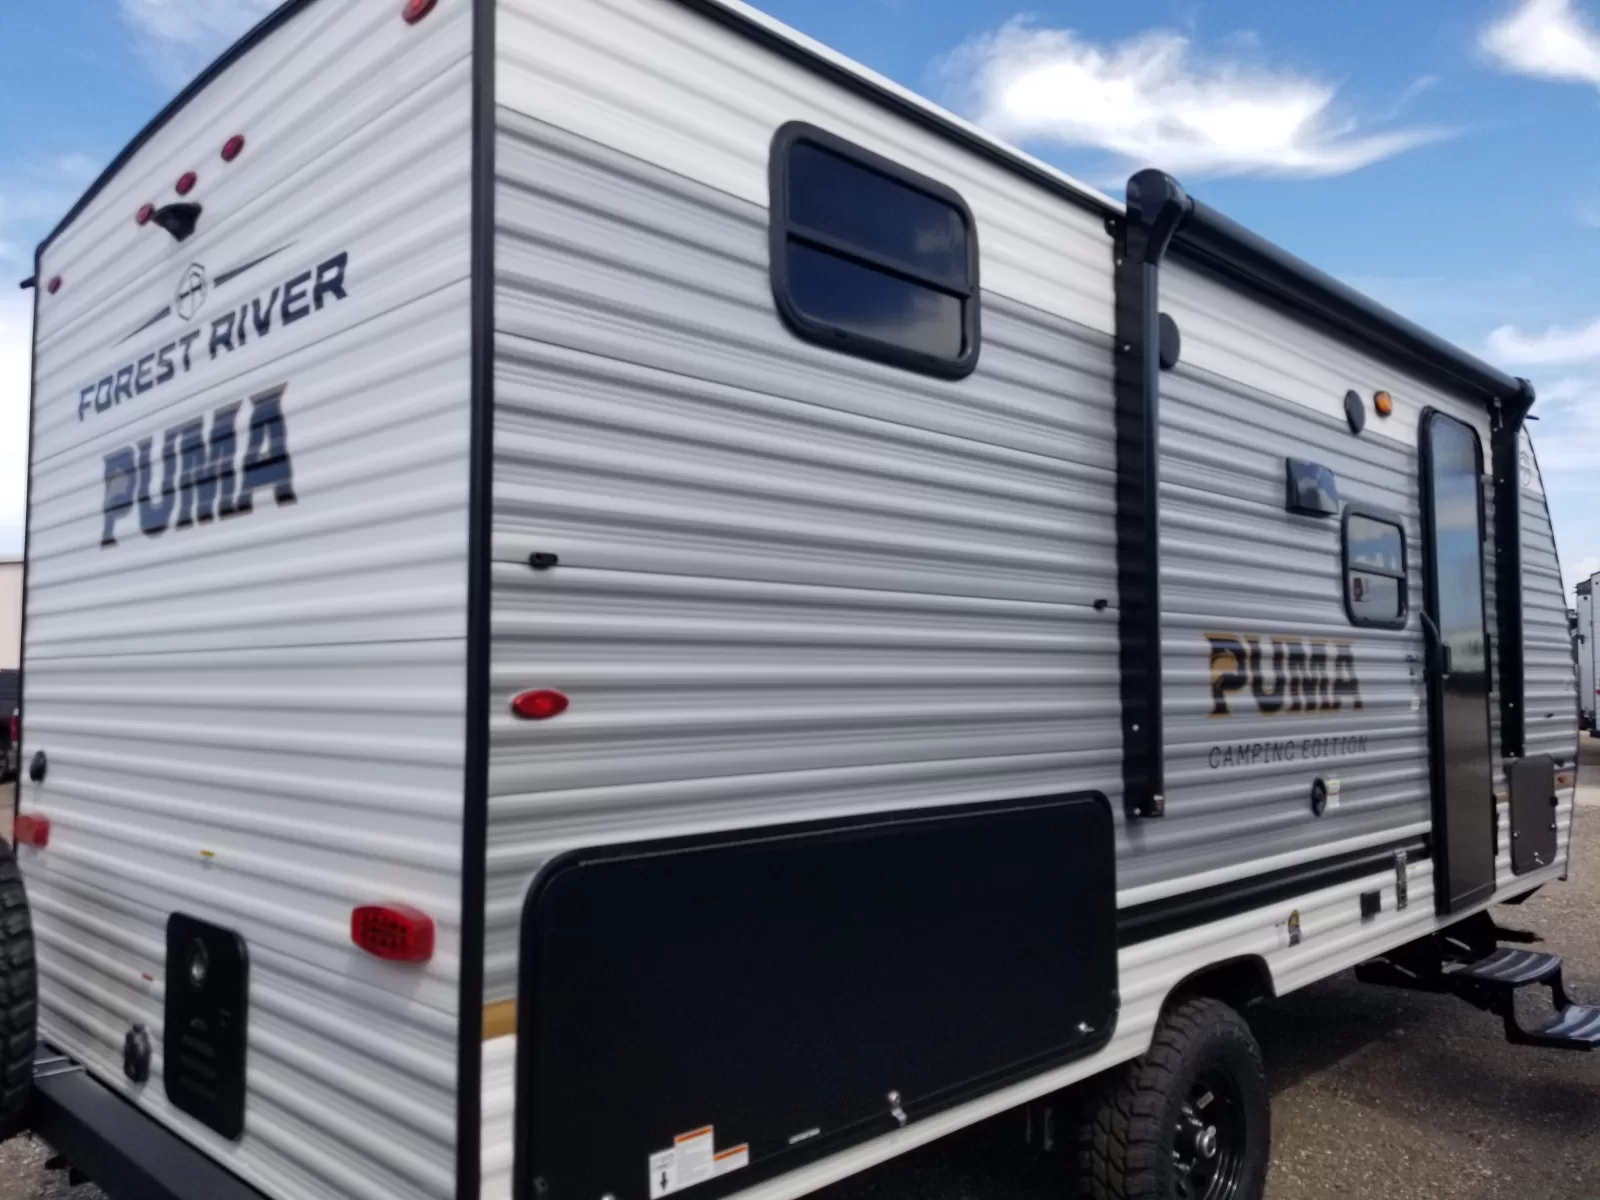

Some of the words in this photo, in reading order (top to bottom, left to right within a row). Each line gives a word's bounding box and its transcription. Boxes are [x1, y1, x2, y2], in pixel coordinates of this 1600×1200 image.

[78, 329, 201, 421] FOREST
[208, 251, 348, 360] RIVER
[101, 381, 297, 546] PUMA
[1204, 633, 1364, 719] PUMA
[1208, 740, 1295, 769] CAMPING
[1302, 736, 1368, 759] EDITION
